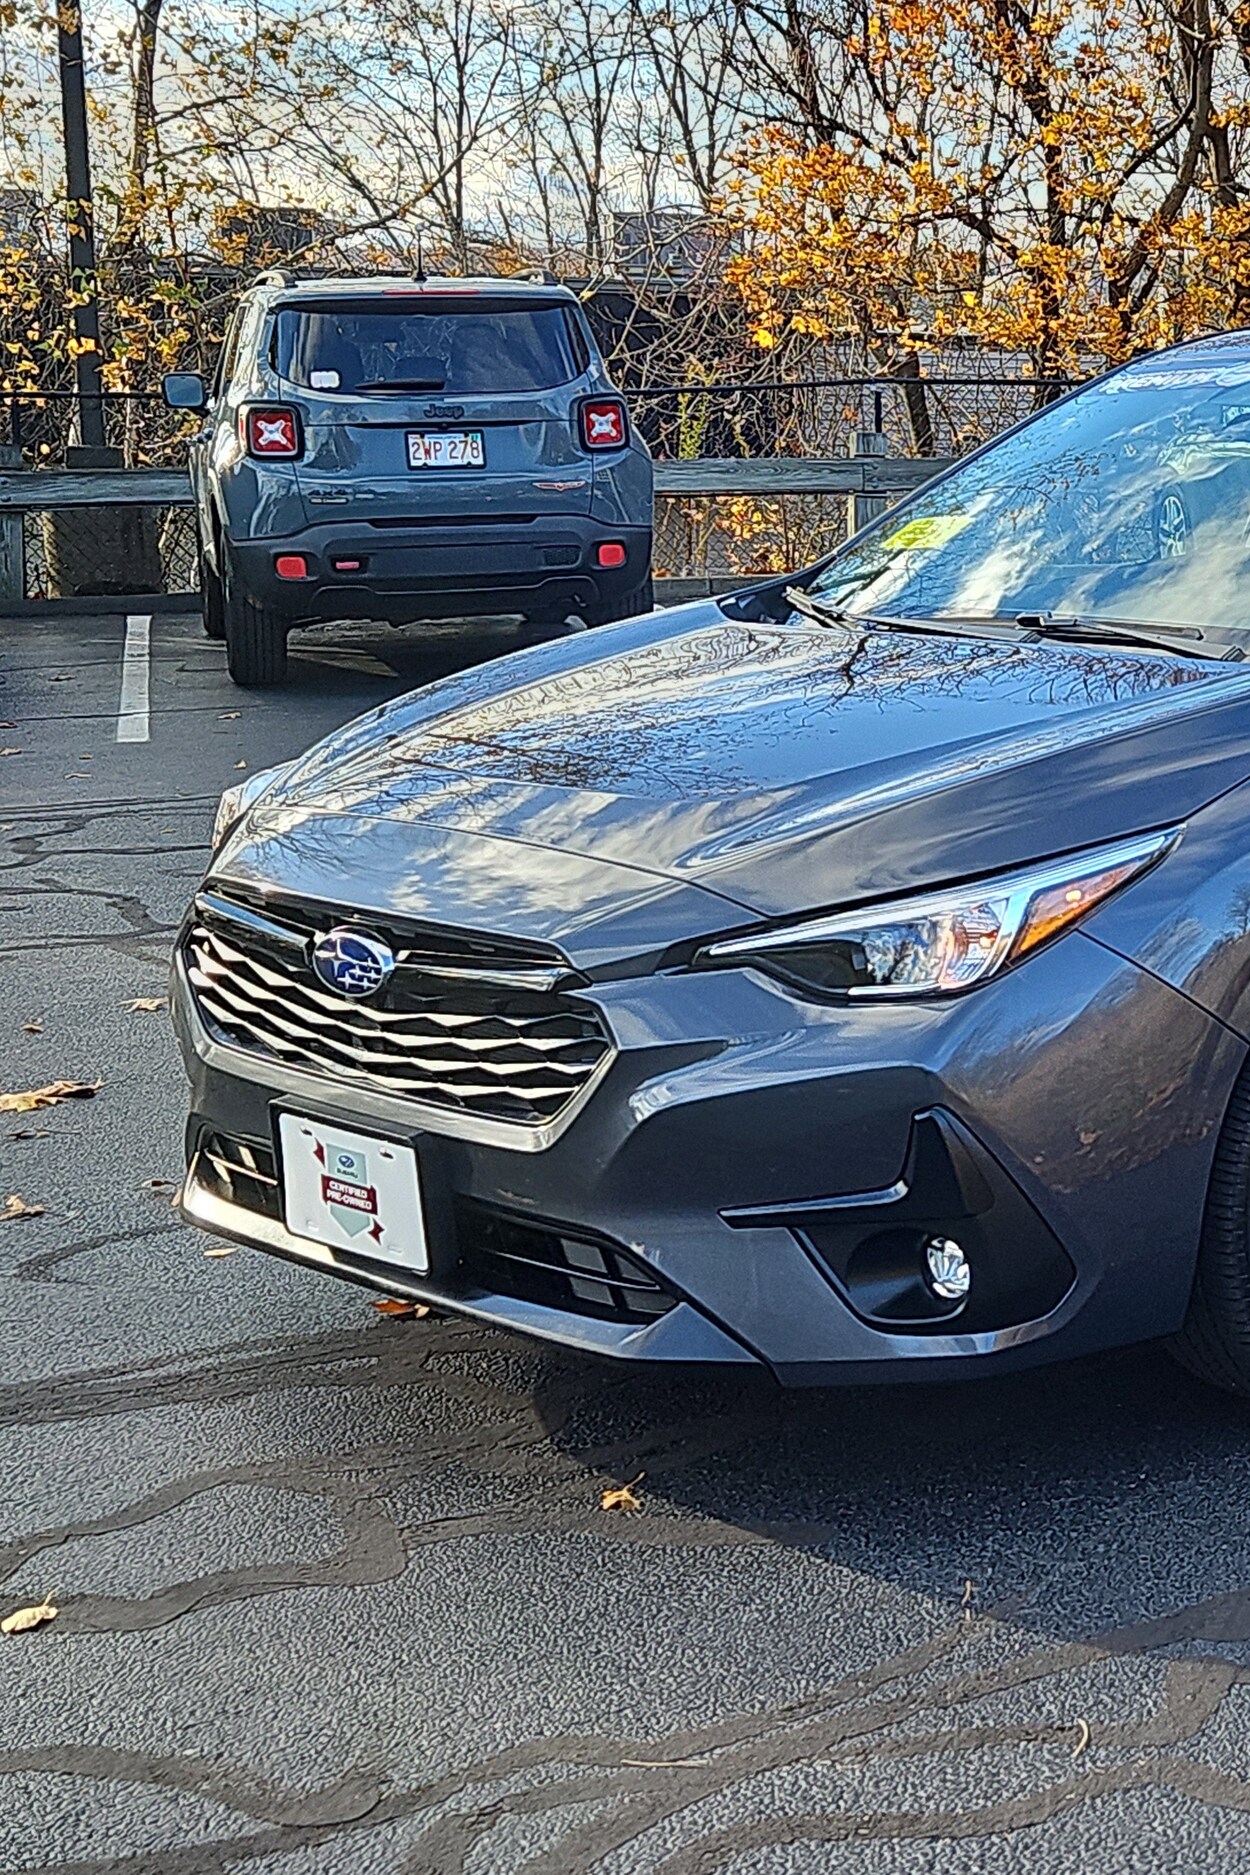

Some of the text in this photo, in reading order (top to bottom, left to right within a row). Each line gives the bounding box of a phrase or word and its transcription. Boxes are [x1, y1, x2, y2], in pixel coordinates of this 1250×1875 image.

[424, 404, 464, 419] Jeep
[411, 440, 480, 461] 2WP 278
[326, 1189, 372, 1210] PRE-OWNED
[329, 1181, 368, 1199] CERTIFIED
